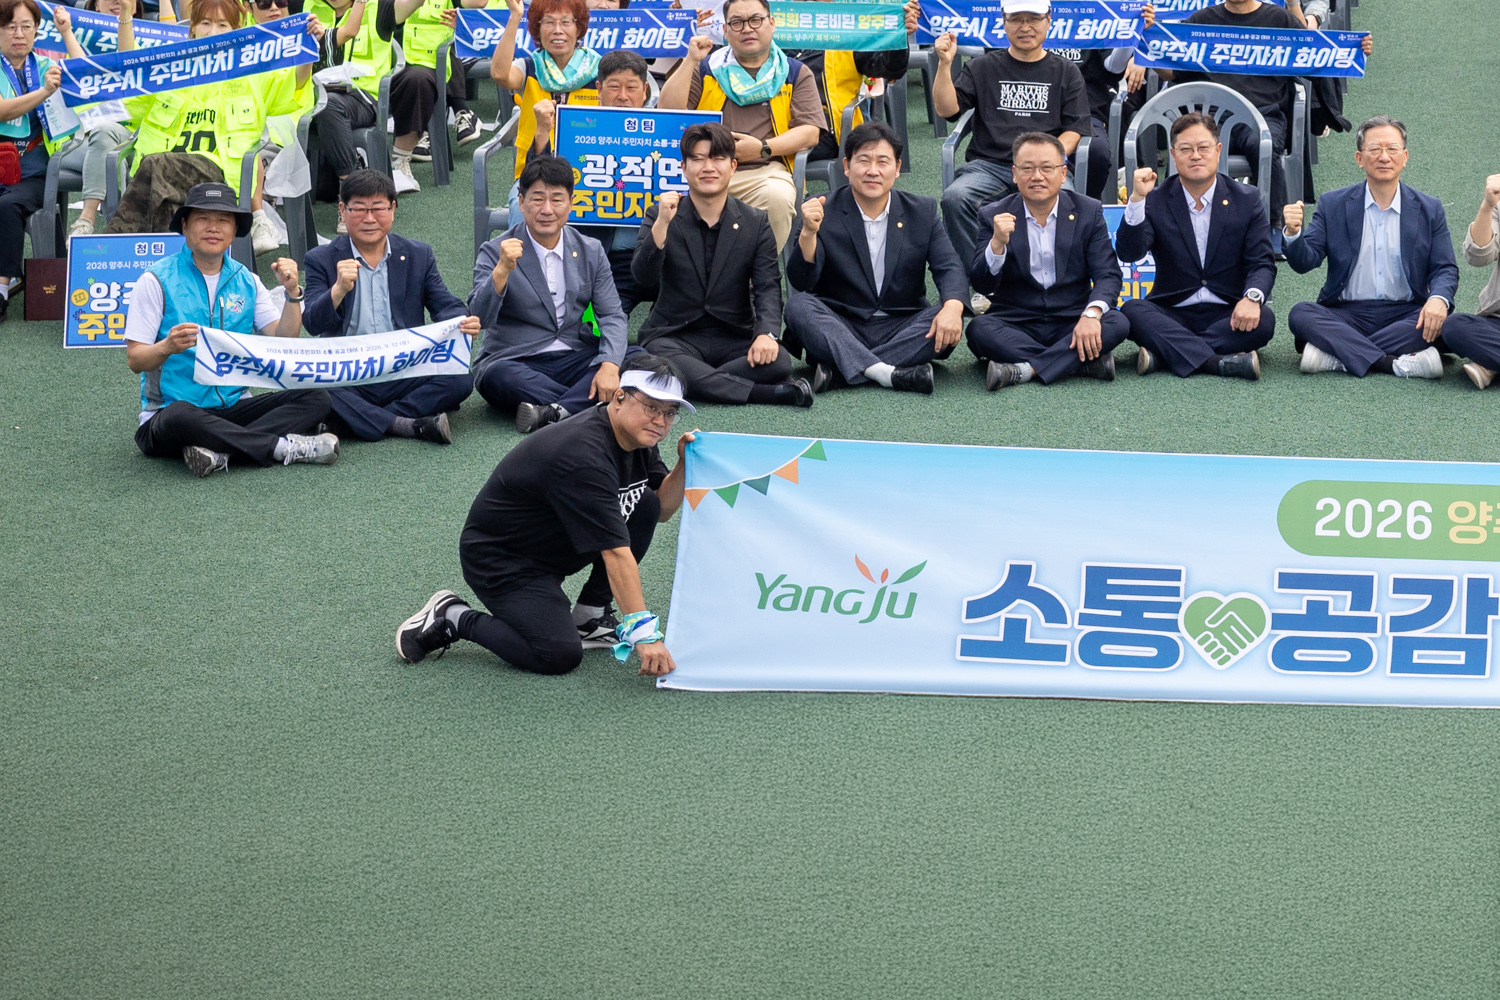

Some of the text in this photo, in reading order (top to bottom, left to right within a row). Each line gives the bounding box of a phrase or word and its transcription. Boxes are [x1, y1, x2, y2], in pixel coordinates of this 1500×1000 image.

[815, 13, 898, 30] 준비된 양주로
[1149, 40, 1357, 68] 양주시 주민자치 화이팅
[79, 34, 302, 98] 양주시 주민자치 화이팅
[1000, 83, 1049, 93] MARITHÉ
[999, 99, 1048, 110] GIRBAUD
[624, 118, 654, 133] 청 팀
[575, 136, 651, 146] 2026 양주시 주민자치
[582, 154, 690, 190] 광적면
[135, 242, 165, 255] 청 팀
[86, 262, 107, 270] 2026
[216, 339, 454, 383] 양주시 주민자치 화이팅
[1313, 496, 1434, 540] 2026
[956, 560, 1186, 672] 소통
